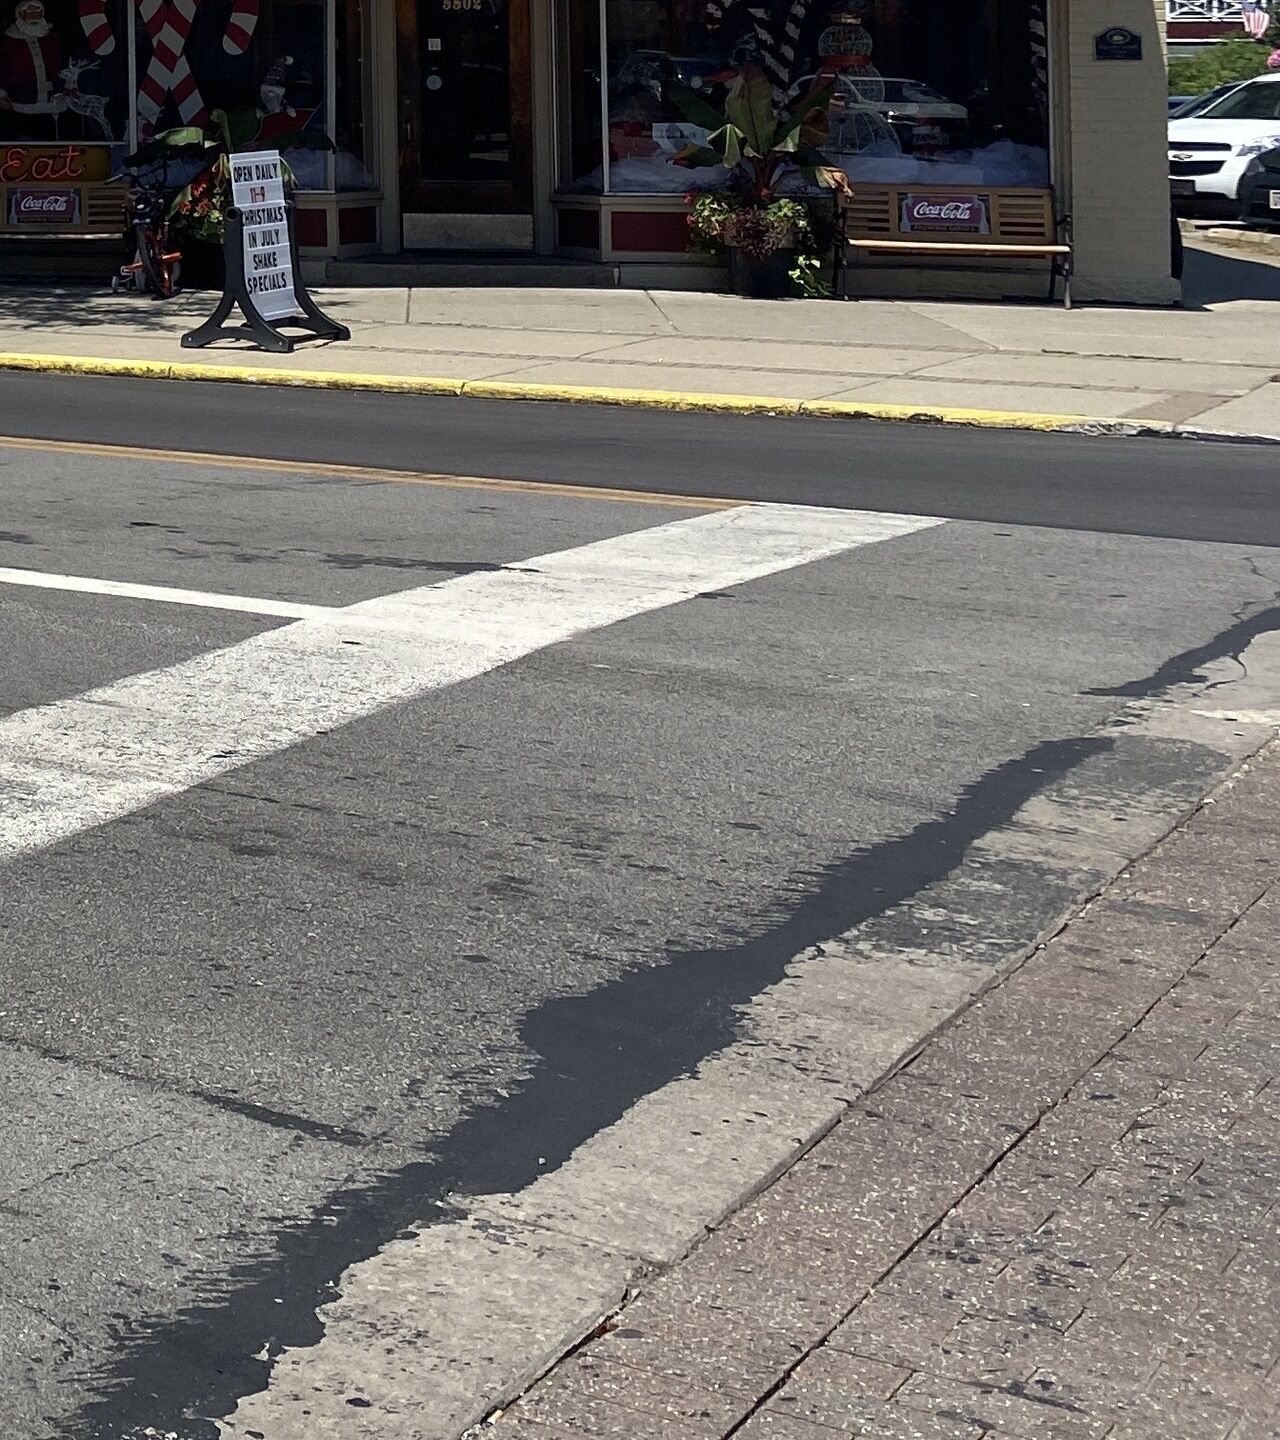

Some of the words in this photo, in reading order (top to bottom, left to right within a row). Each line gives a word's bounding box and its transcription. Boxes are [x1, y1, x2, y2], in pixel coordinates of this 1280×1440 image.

[0, 145, 82, 183] Eat
[233, 166, 254, 184] OPEN
[255, 162, 279, 180] DAILY
[20, 195, 69, 212] Coca-Cola
[913, 201, 973, 219] Coca-Cola
[248, 231, 258, 249] IN
[261, 228, 281, 247] JULY
[252, 251, 278, 271] SHAKE
[247, 272, 287, 295] SPECIALS
